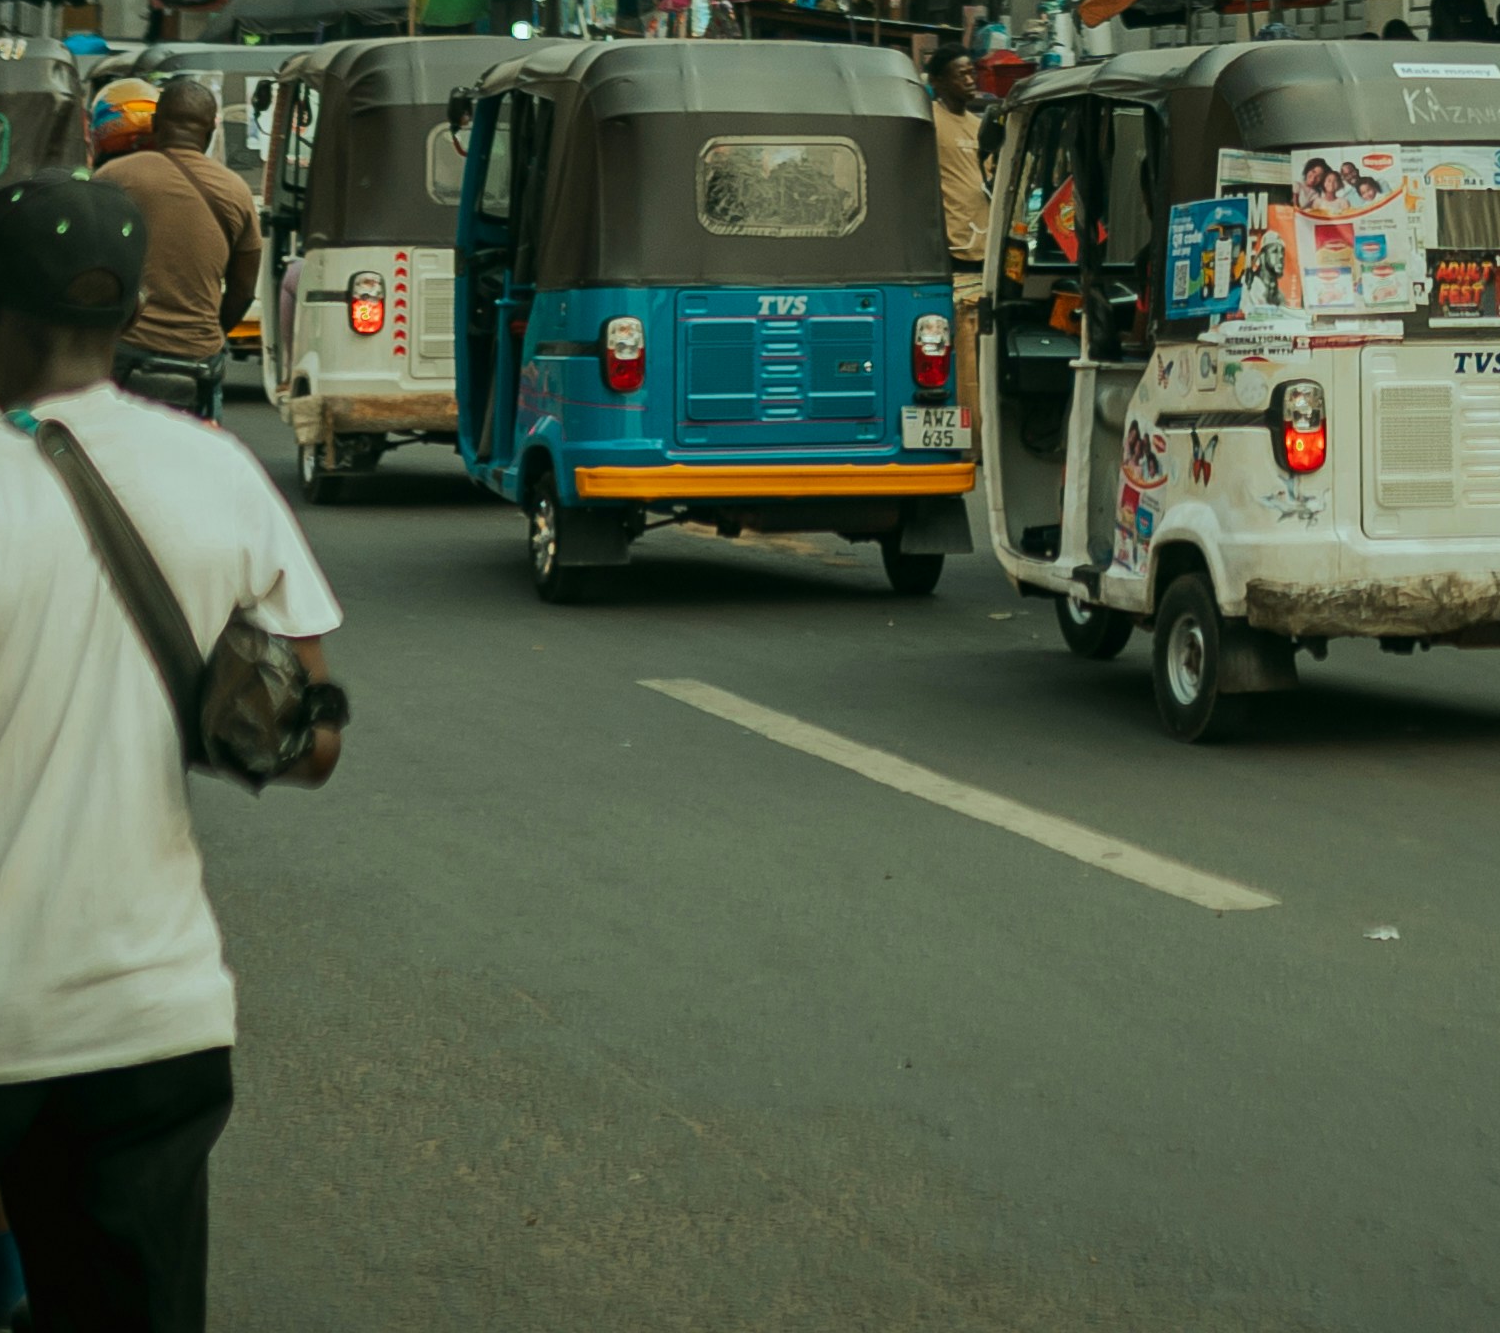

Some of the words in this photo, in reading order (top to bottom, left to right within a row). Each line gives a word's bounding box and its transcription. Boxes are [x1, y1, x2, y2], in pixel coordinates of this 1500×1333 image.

[757, 295, 808, 315] TVS
[922, 410, 956, 428] AWZ
[922, 430, 954, 448] 635
